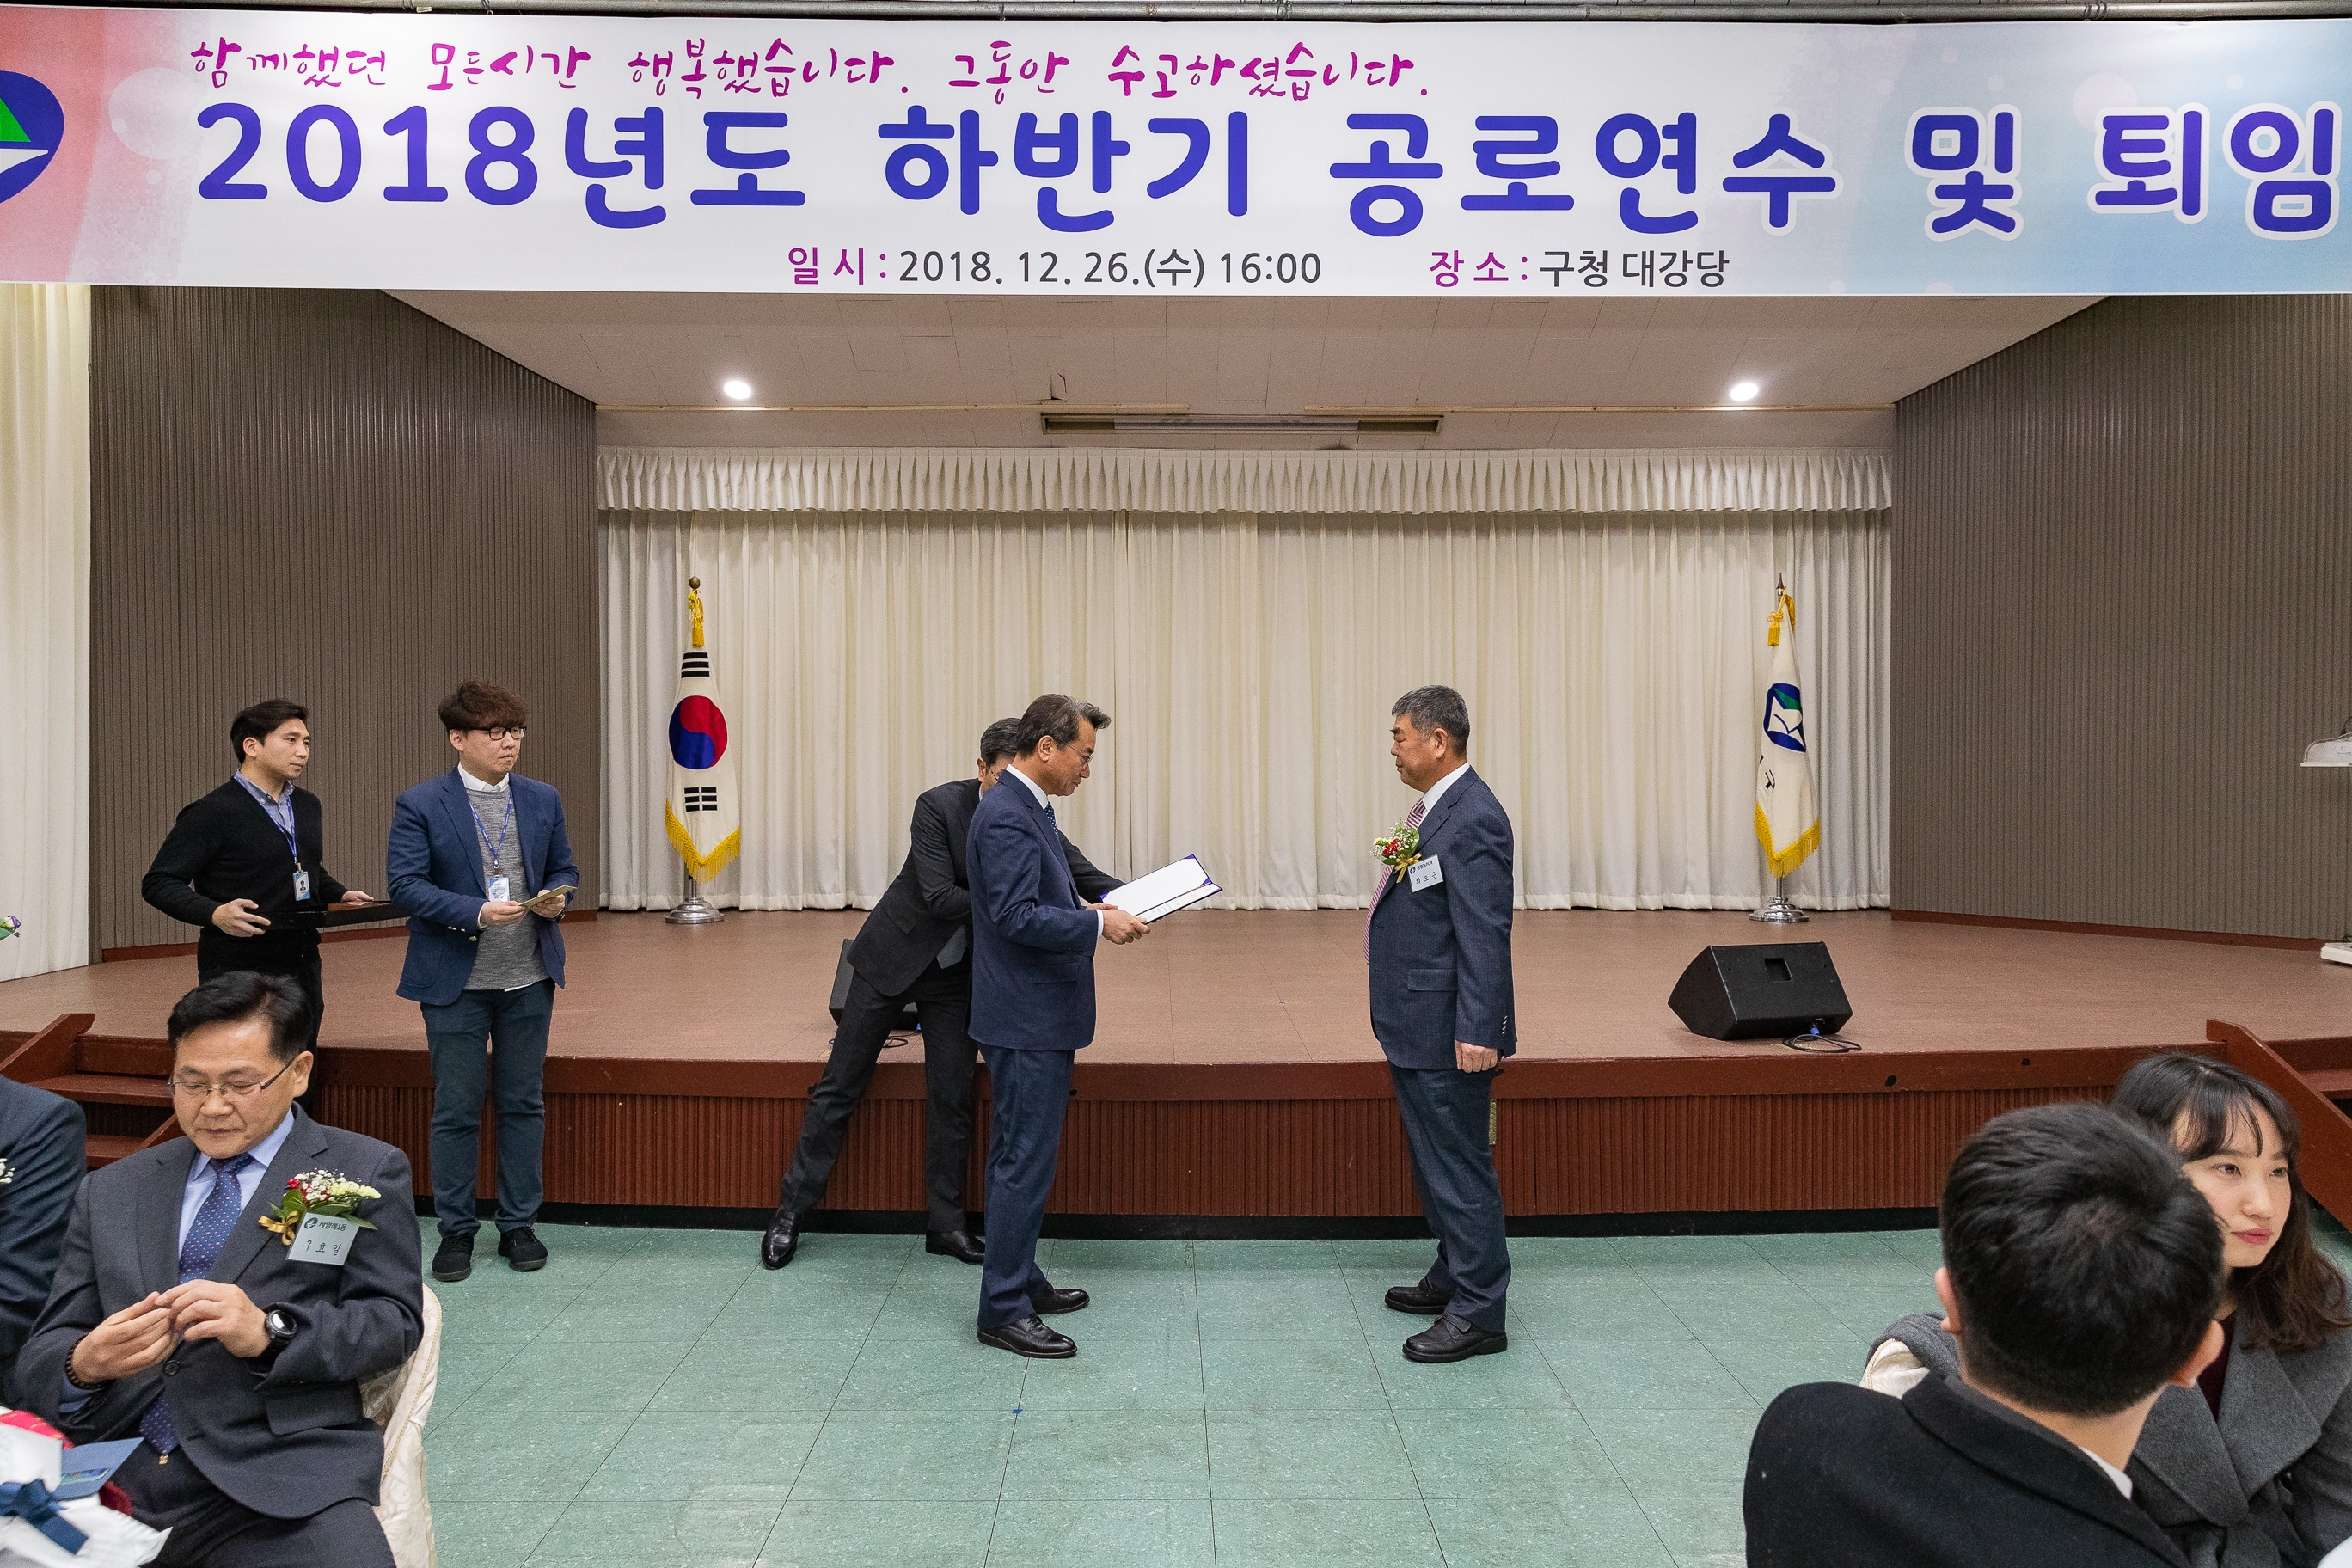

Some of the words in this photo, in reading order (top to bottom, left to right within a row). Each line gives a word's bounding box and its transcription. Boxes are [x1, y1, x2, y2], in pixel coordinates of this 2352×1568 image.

[190, 37, 386, 89] 함께했던
[427, 43, 591, 91] 모든시간
[628, 37, 909, 98] 행복했습니다.
[948, 40, 1069, 105] 그동안
[1107, 41, 1428, 101] 수고하셨습니다.
[197, 102, 805, 229] 2018년도
[878, 105, 1248, 233] 하반기
[1329, 112, 1836, 237] 공로연수
[1912, 112, 2016, 234] 및
[2095, 108, 2334, 232] 퇴임
[1220, 252, 1321, 284] 16:00
[1539, 249, 1608, 288] 구청
[1622, 249, 1730, 288] 대강당
